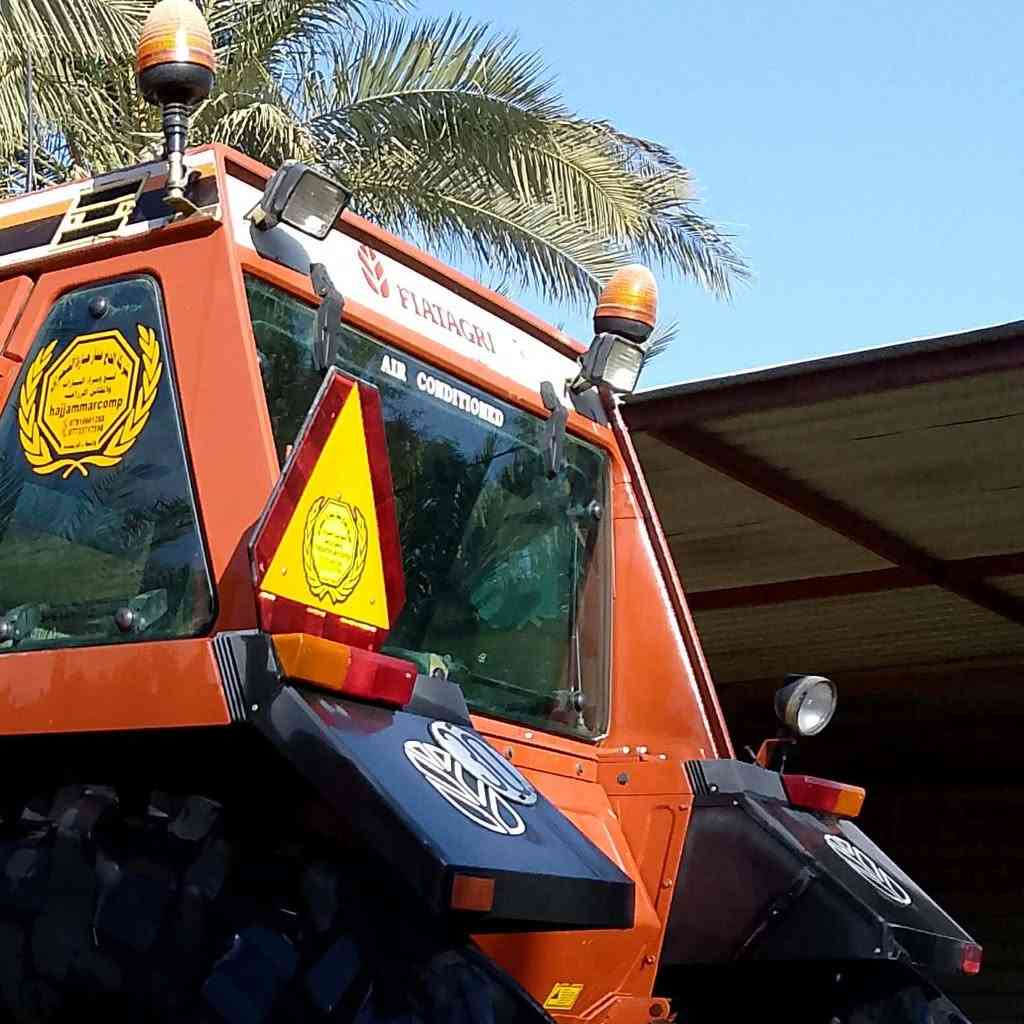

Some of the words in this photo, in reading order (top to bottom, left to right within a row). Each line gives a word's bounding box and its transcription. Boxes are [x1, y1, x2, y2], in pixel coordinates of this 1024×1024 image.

[398, 286, 496, 353] FIATAGRI
[49, 398, 123, 417] hajjammarcomp
[381, 355, 408, 382] AIR
[416, 372, 505, 428] CONDITIONED
